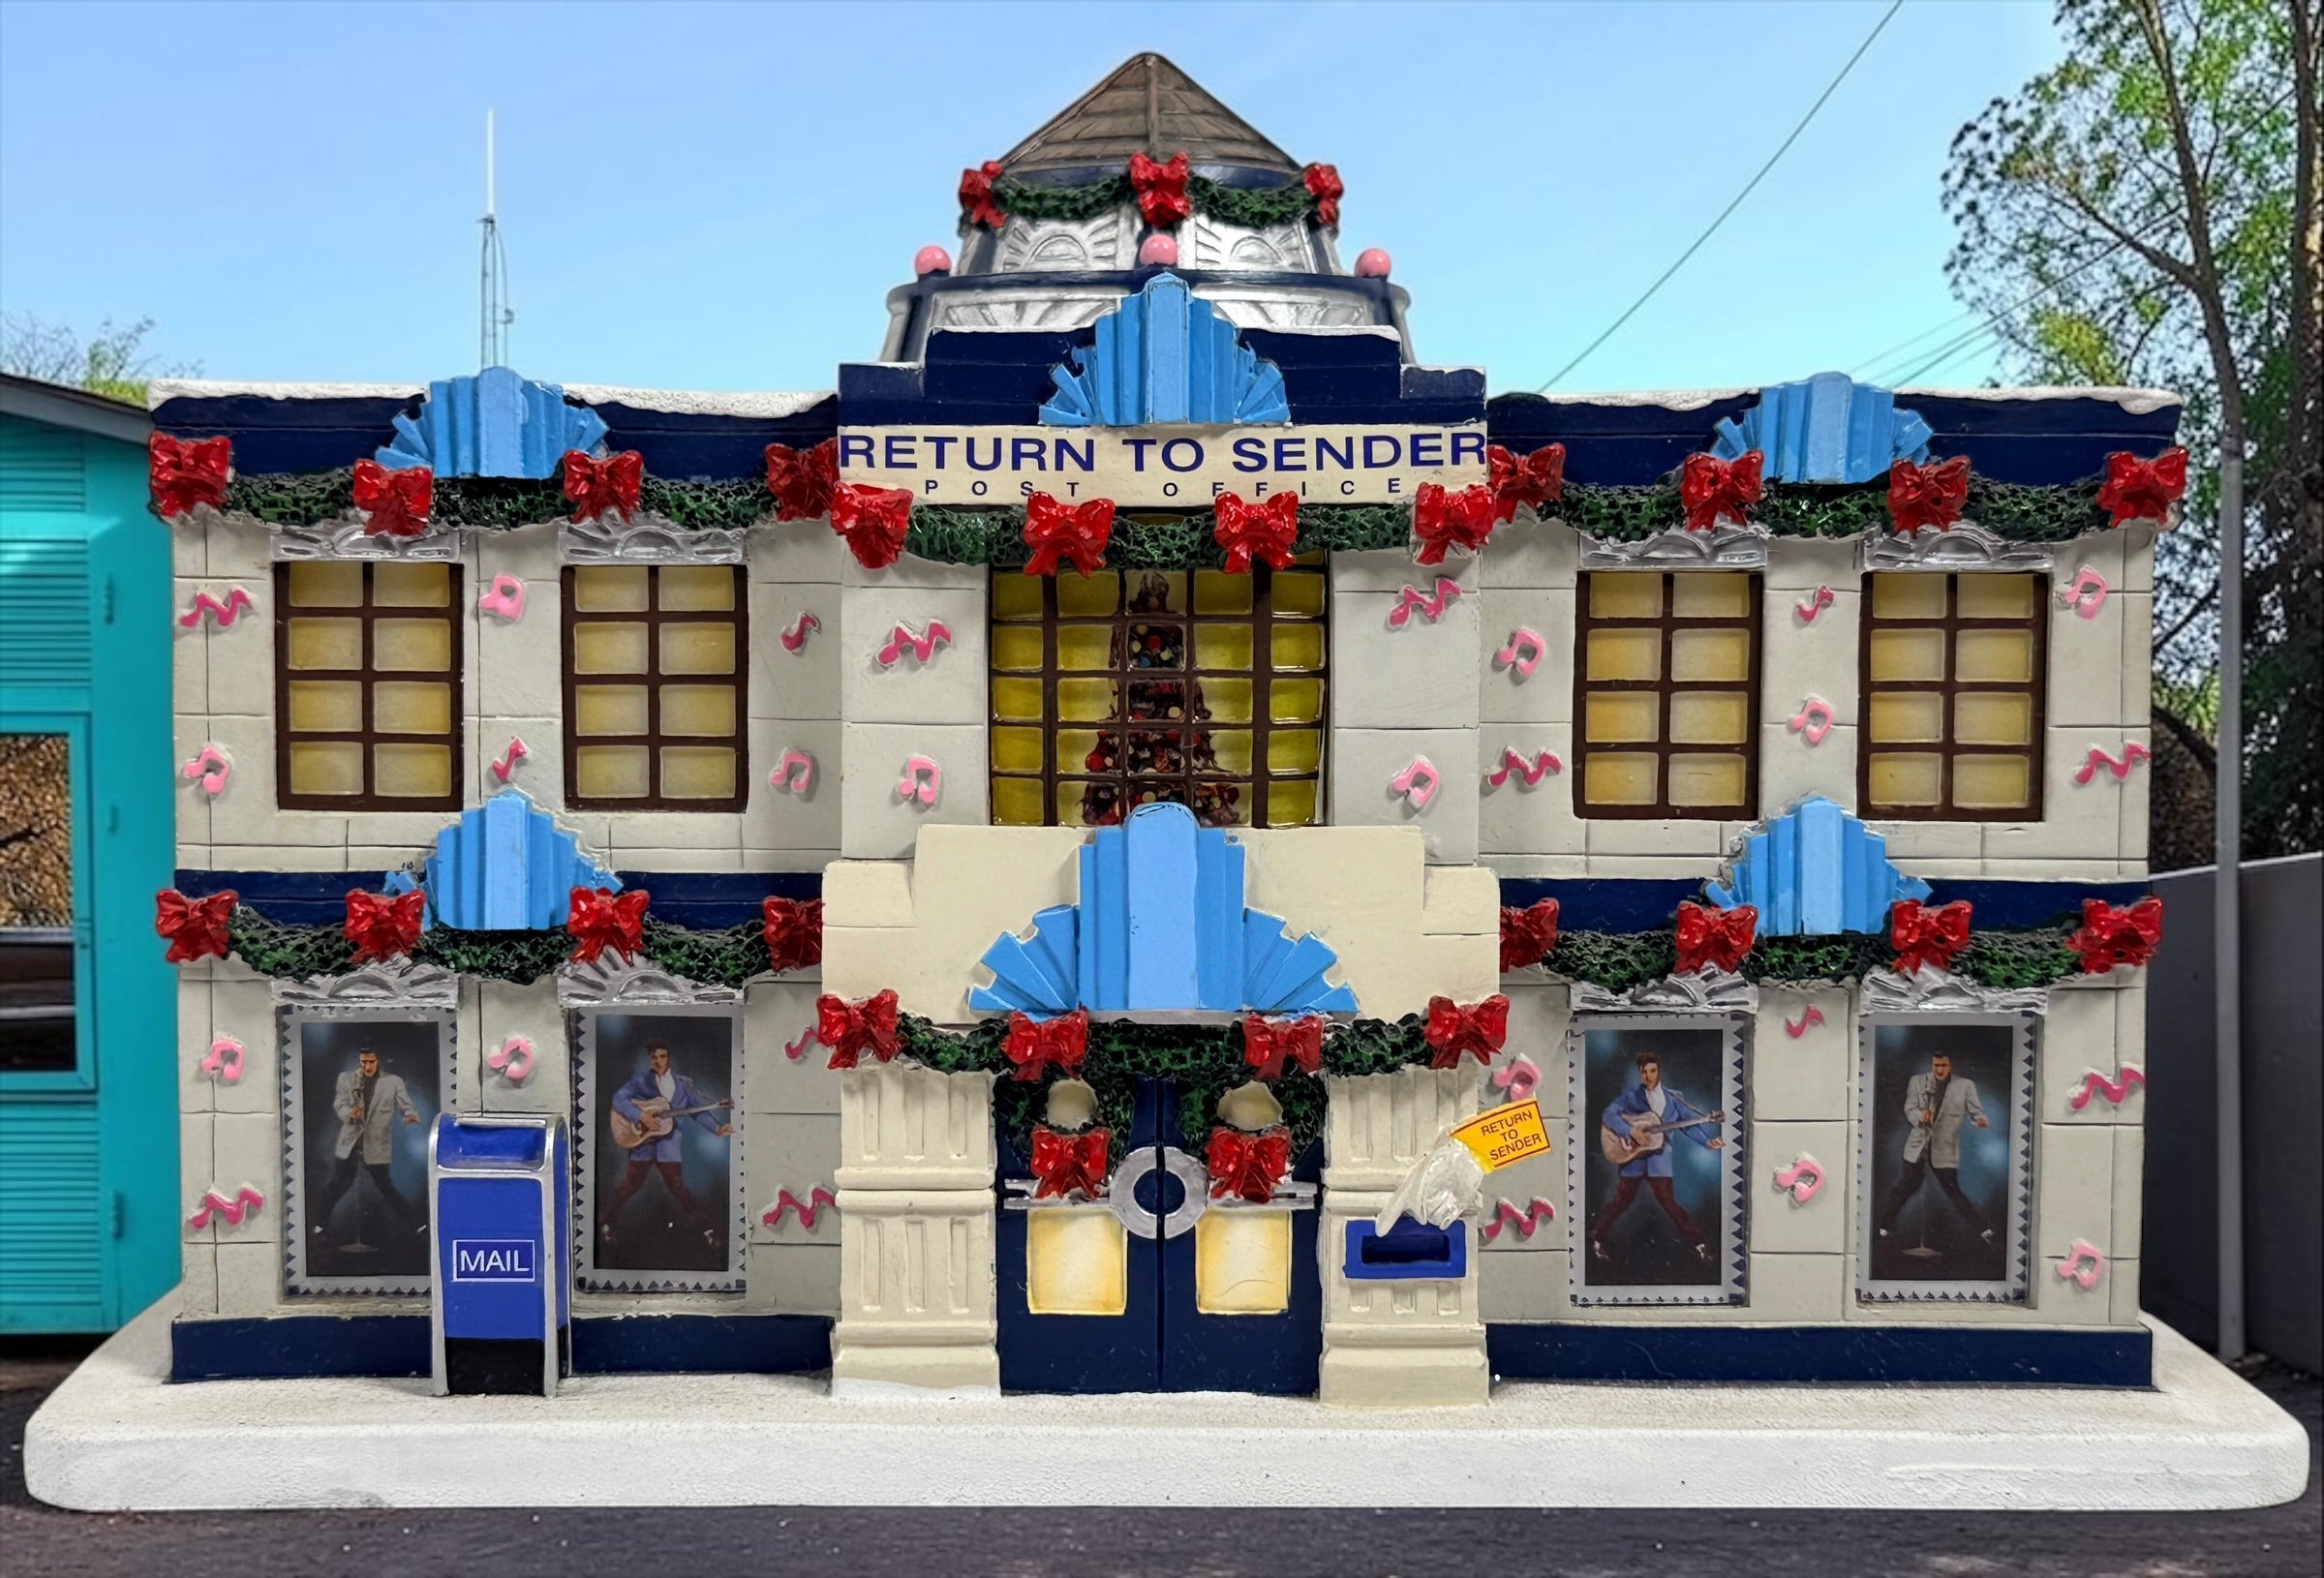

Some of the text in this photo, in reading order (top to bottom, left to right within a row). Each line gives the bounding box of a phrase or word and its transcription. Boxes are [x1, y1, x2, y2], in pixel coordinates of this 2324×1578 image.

[841, 432, 1486, 472] RETURN TO SENDER
[925, 477, 1401, 498] POST OFFICE
[1481, 1109, 1533, 1137] RETURN
[1499, 1129, 1518, 1142] TO
[1489, 1133, 1542, 1161] SENDER
[460, 1249, 530, 1272] MAIL
